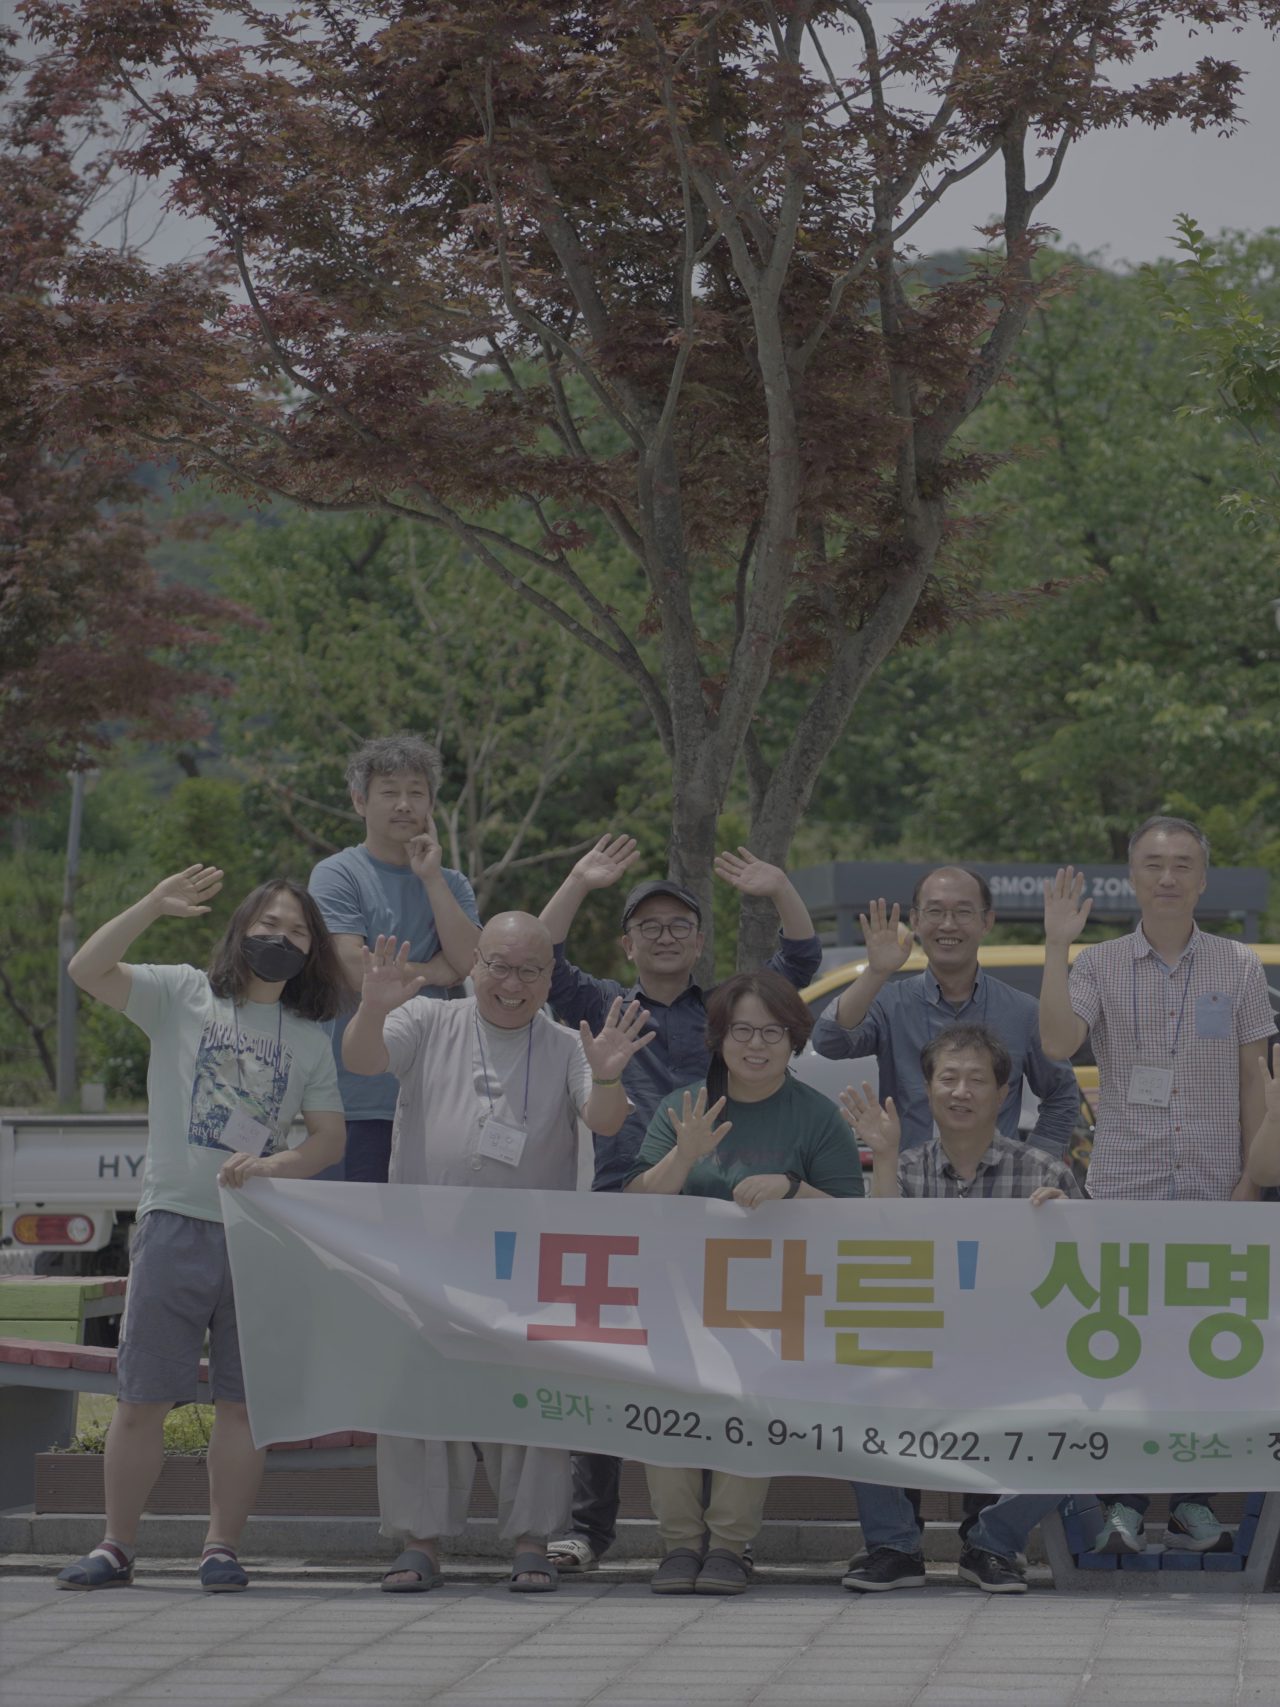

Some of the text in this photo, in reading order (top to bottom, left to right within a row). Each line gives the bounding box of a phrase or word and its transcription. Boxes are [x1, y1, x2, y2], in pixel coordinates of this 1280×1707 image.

[989, 875, 1087, 896] SMOKG
[536, 1387, 595, 1426] 일자
[624, 1403, 713, 1442] 2022.
[725, 1417, 754, 1448] 6.
[768, 1418, 845, 1453] 9~11
[862, 1426, 888, 1455] &
[898, 1430, 991, 1463] 2022.
[1003, 1431, 1034, 1463] 7.
[1048, 1431, 1110, 1462] 7~9
[1168, 1431, 1233, 1463] 장소
